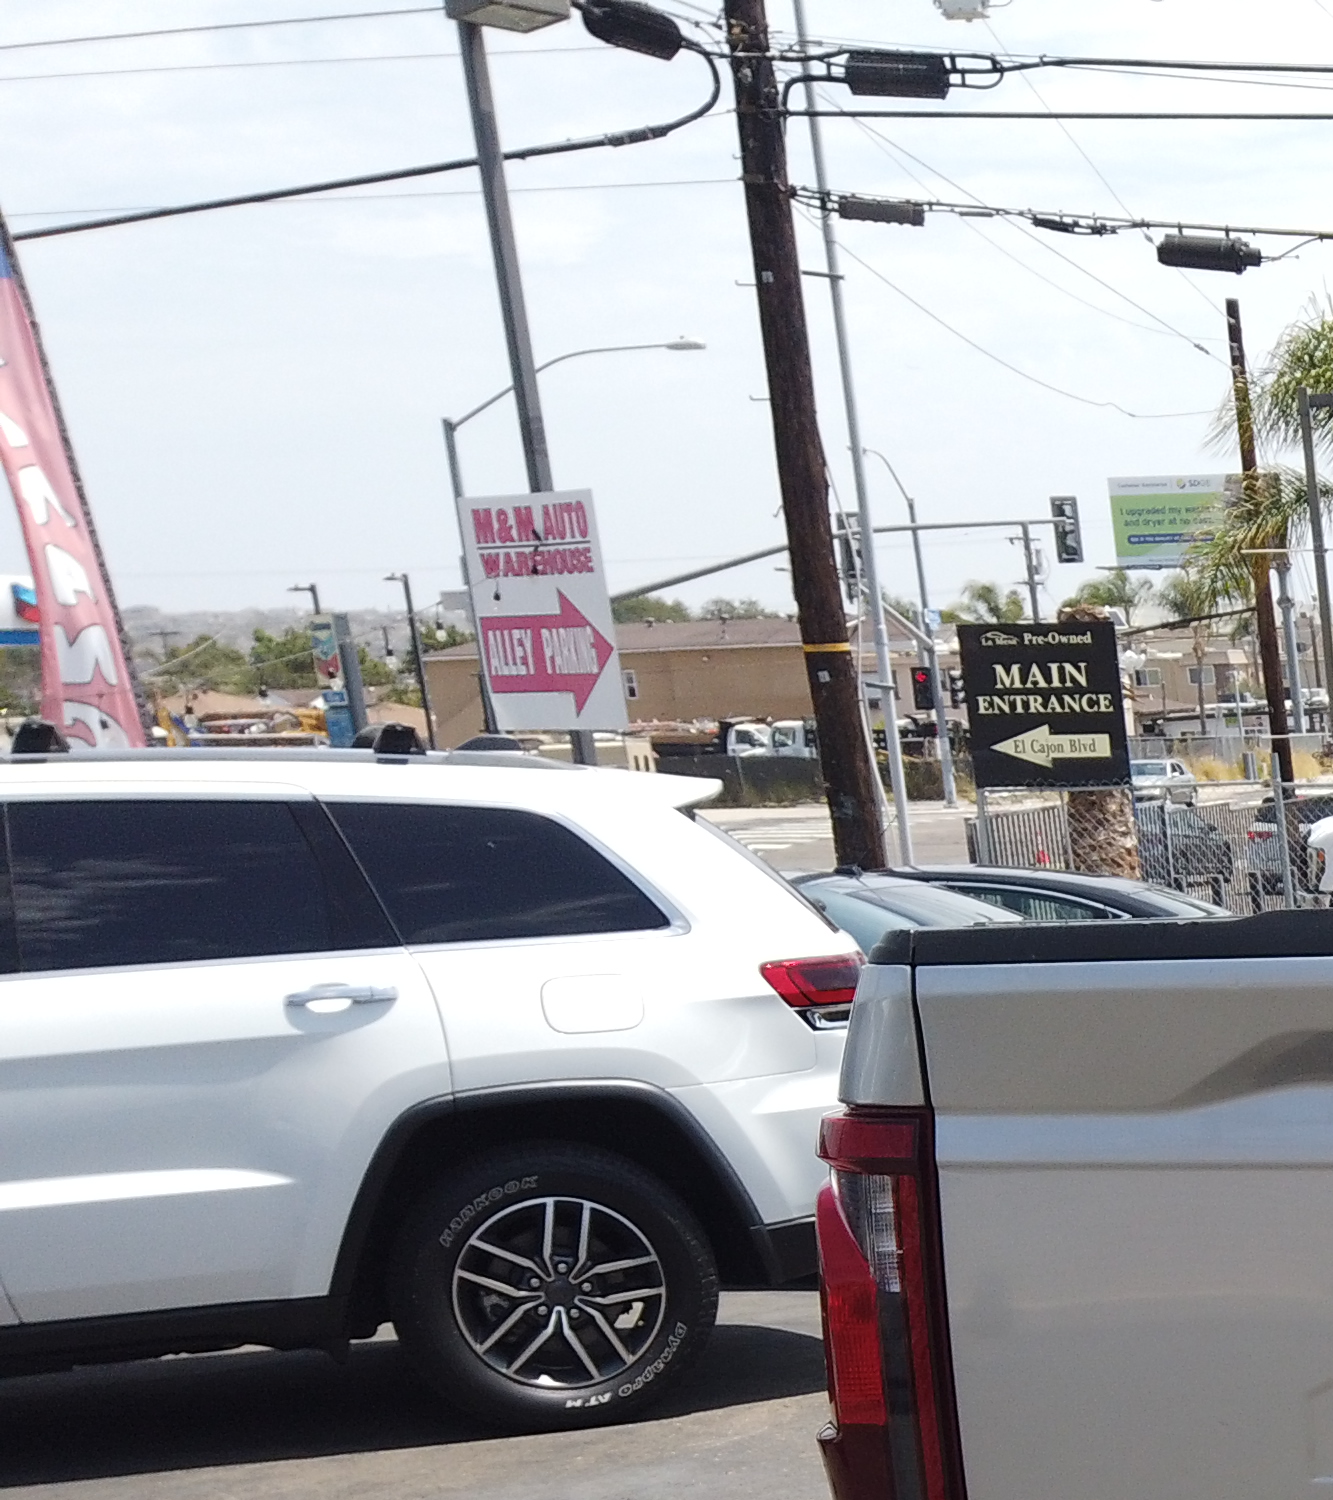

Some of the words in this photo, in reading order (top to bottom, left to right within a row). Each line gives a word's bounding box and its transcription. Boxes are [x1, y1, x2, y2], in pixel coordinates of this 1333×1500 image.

[471, 505, 537, 544] M&M
[541, 500, 589, 541] AUTO
[480, 547, 595, 579] WAREHOUSE
[487, 628, 535, 676] ALLEY
[540, 625, 600, 675] PARKING
[1023, 631, 1092, 645] Pre-Owned
[992, 662, 1087, 689] MAIN
[976, 693, 1114, 714] ENTRANCE
[1013, 740, 1026, 753] El
[1030, 739, 1064, 757] Cajon
[1069, 738, 1096, 752] Blvd
